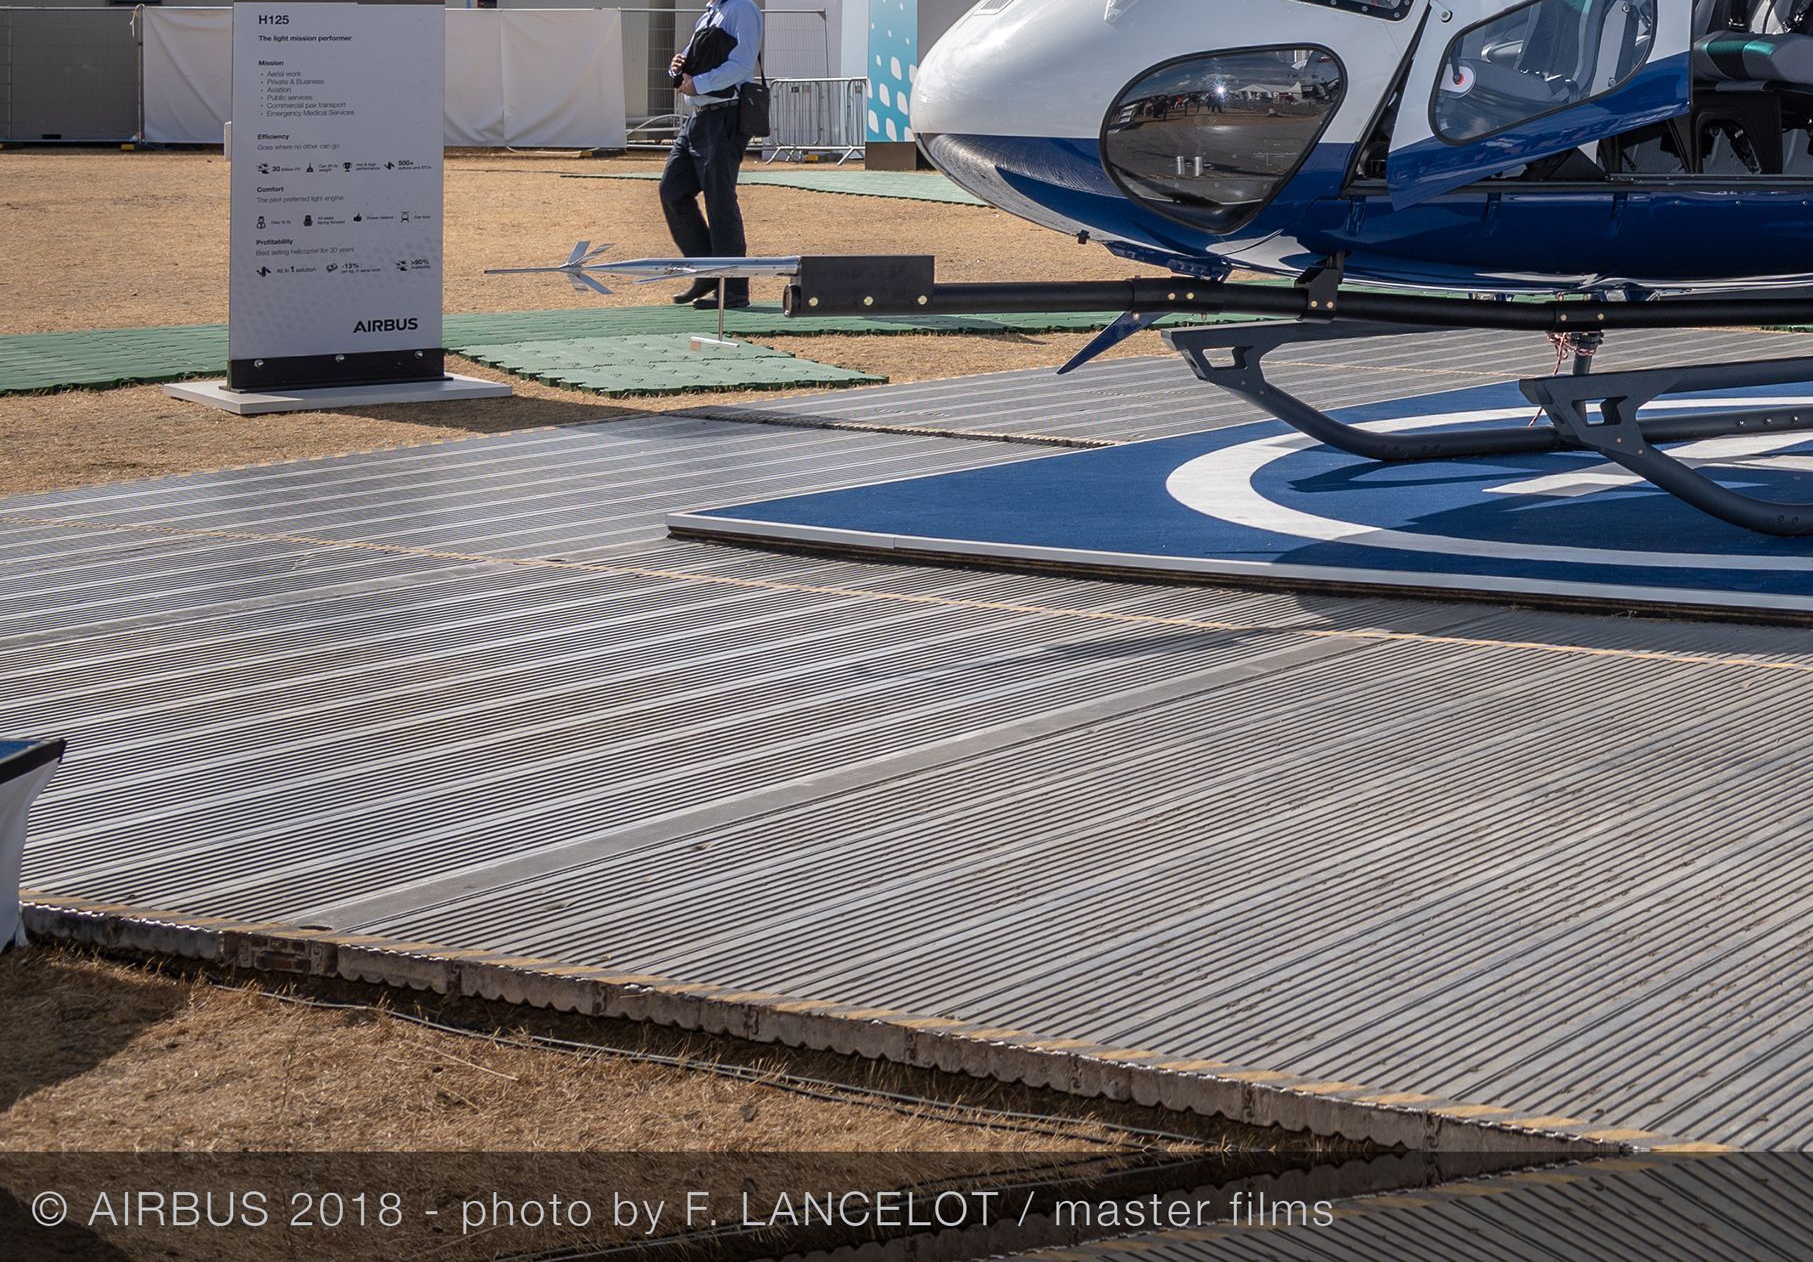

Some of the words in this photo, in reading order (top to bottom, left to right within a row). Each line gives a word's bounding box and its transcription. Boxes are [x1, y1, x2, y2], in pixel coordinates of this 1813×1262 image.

[258, 15, 289, 25] H125
[273, 35, 288, 43] light
[318, 35, 352, 43] performer
[353, 318, 418, 333] AIRBUS
